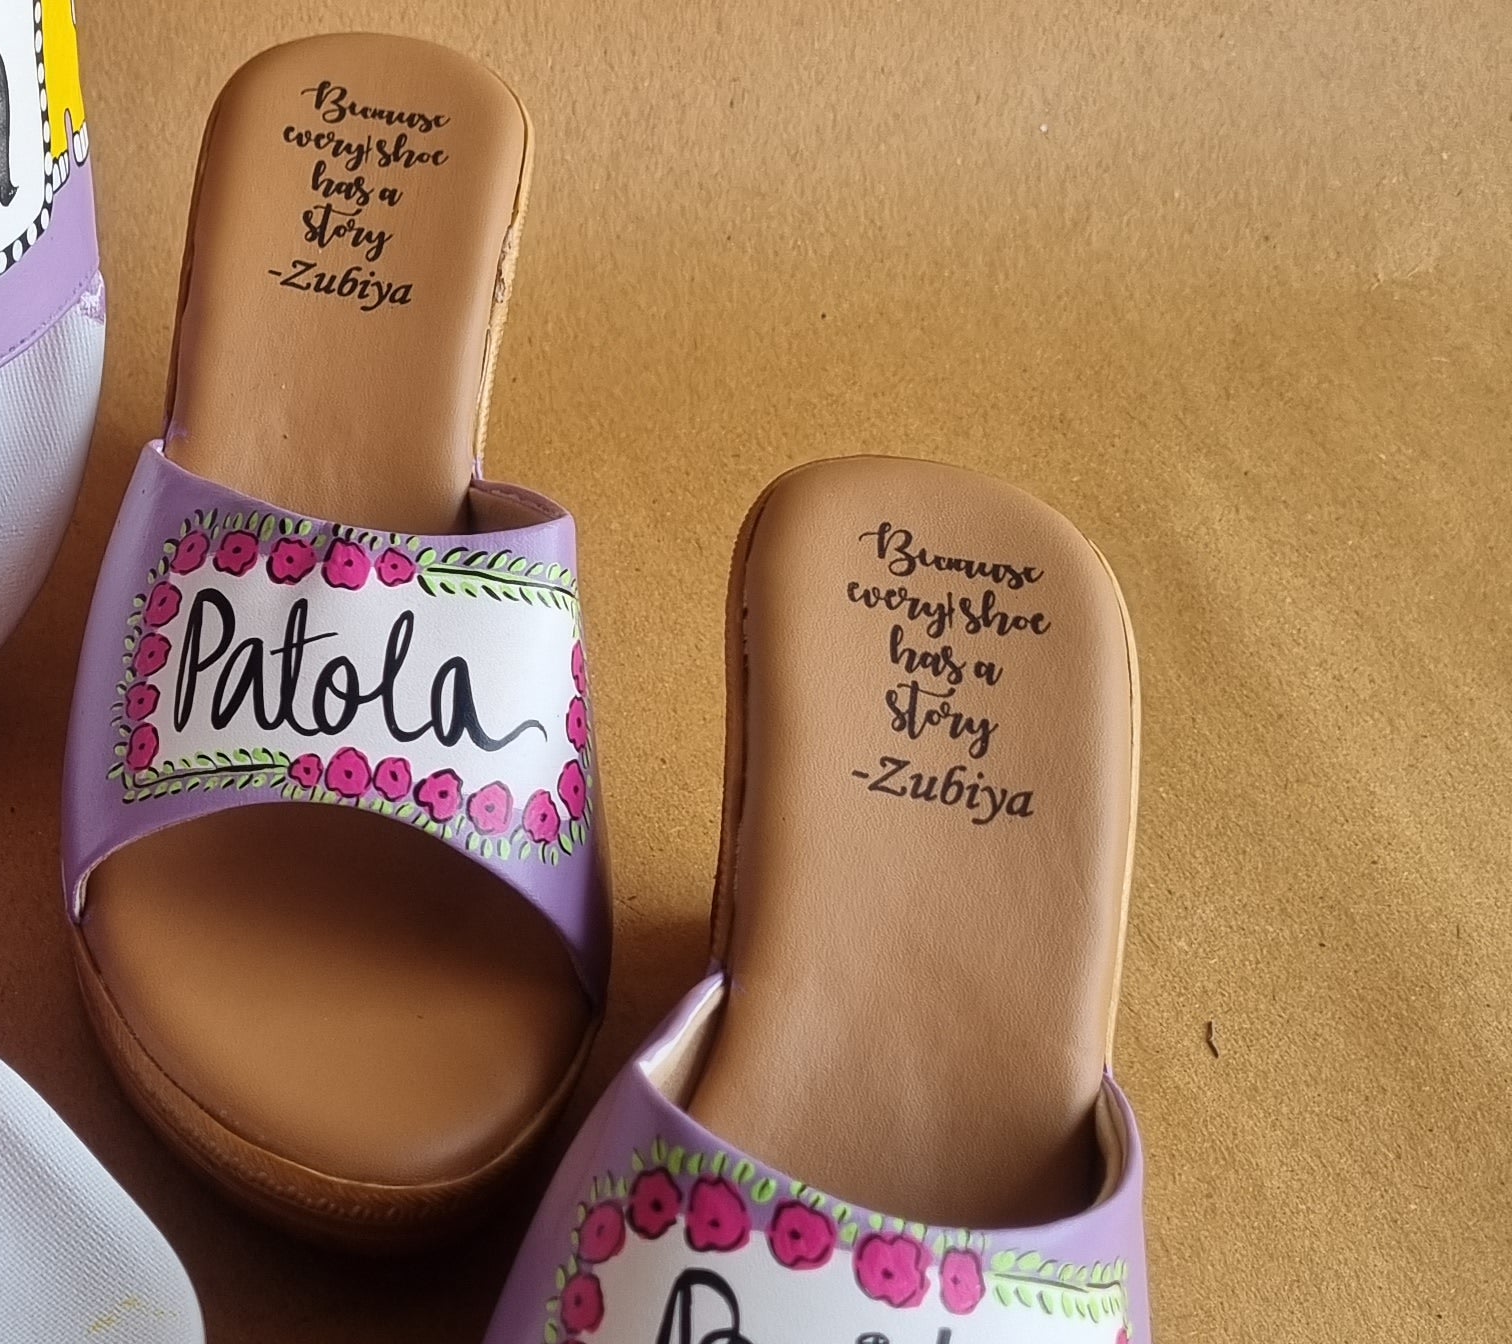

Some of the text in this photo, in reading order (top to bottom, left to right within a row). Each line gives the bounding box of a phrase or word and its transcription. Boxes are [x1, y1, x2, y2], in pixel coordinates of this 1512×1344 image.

[300, 80, 451, 134] Because
[282, 125, 450, 172] every shoe
[311, 159, 404, 207] has a
[302, 202, 394, 263] story
[858, 521, 1045, 591] Because
[846, 581, 1052, 639] every shoe
[173, 587, 549, 753] Patola
[889, 623, 1004, 687] has a
[885, 679, 1000, 760] story
